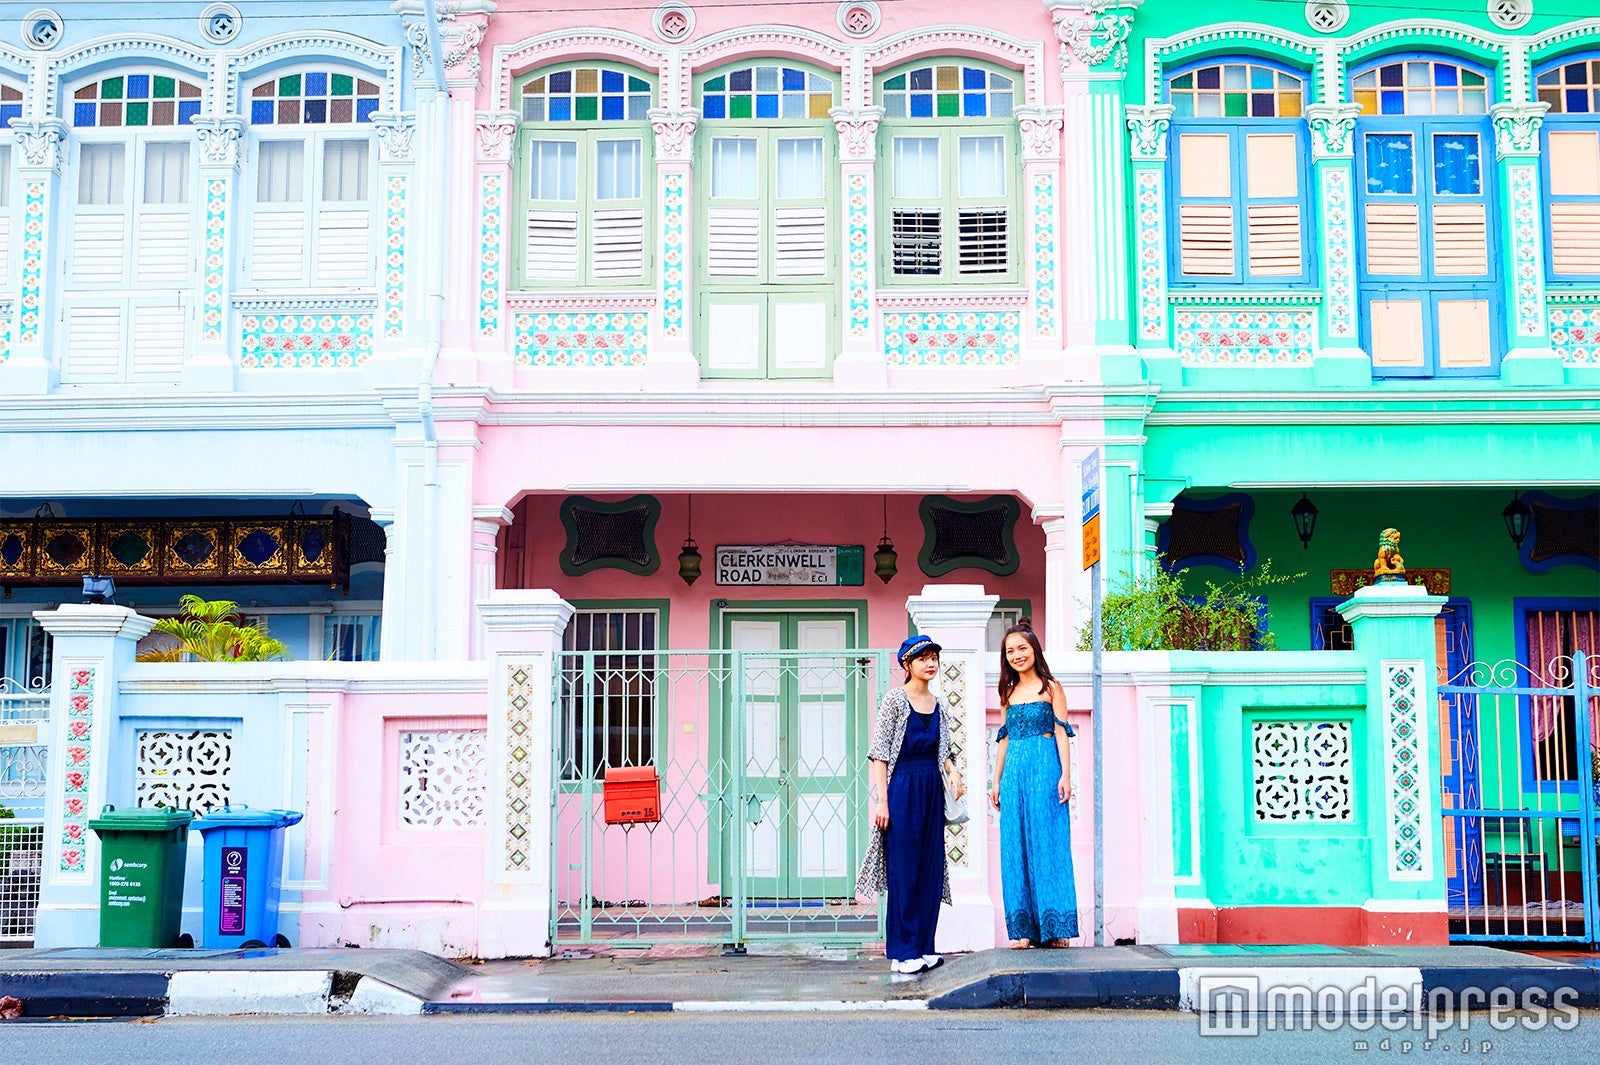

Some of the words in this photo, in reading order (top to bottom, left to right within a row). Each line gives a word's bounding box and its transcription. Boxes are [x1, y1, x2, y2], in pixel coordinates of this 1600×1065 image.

[720, 554, 826, 568] CLERKENWELL
[720, 569, 762, 583] ROAD
[643, 807, 655, 818] 15
